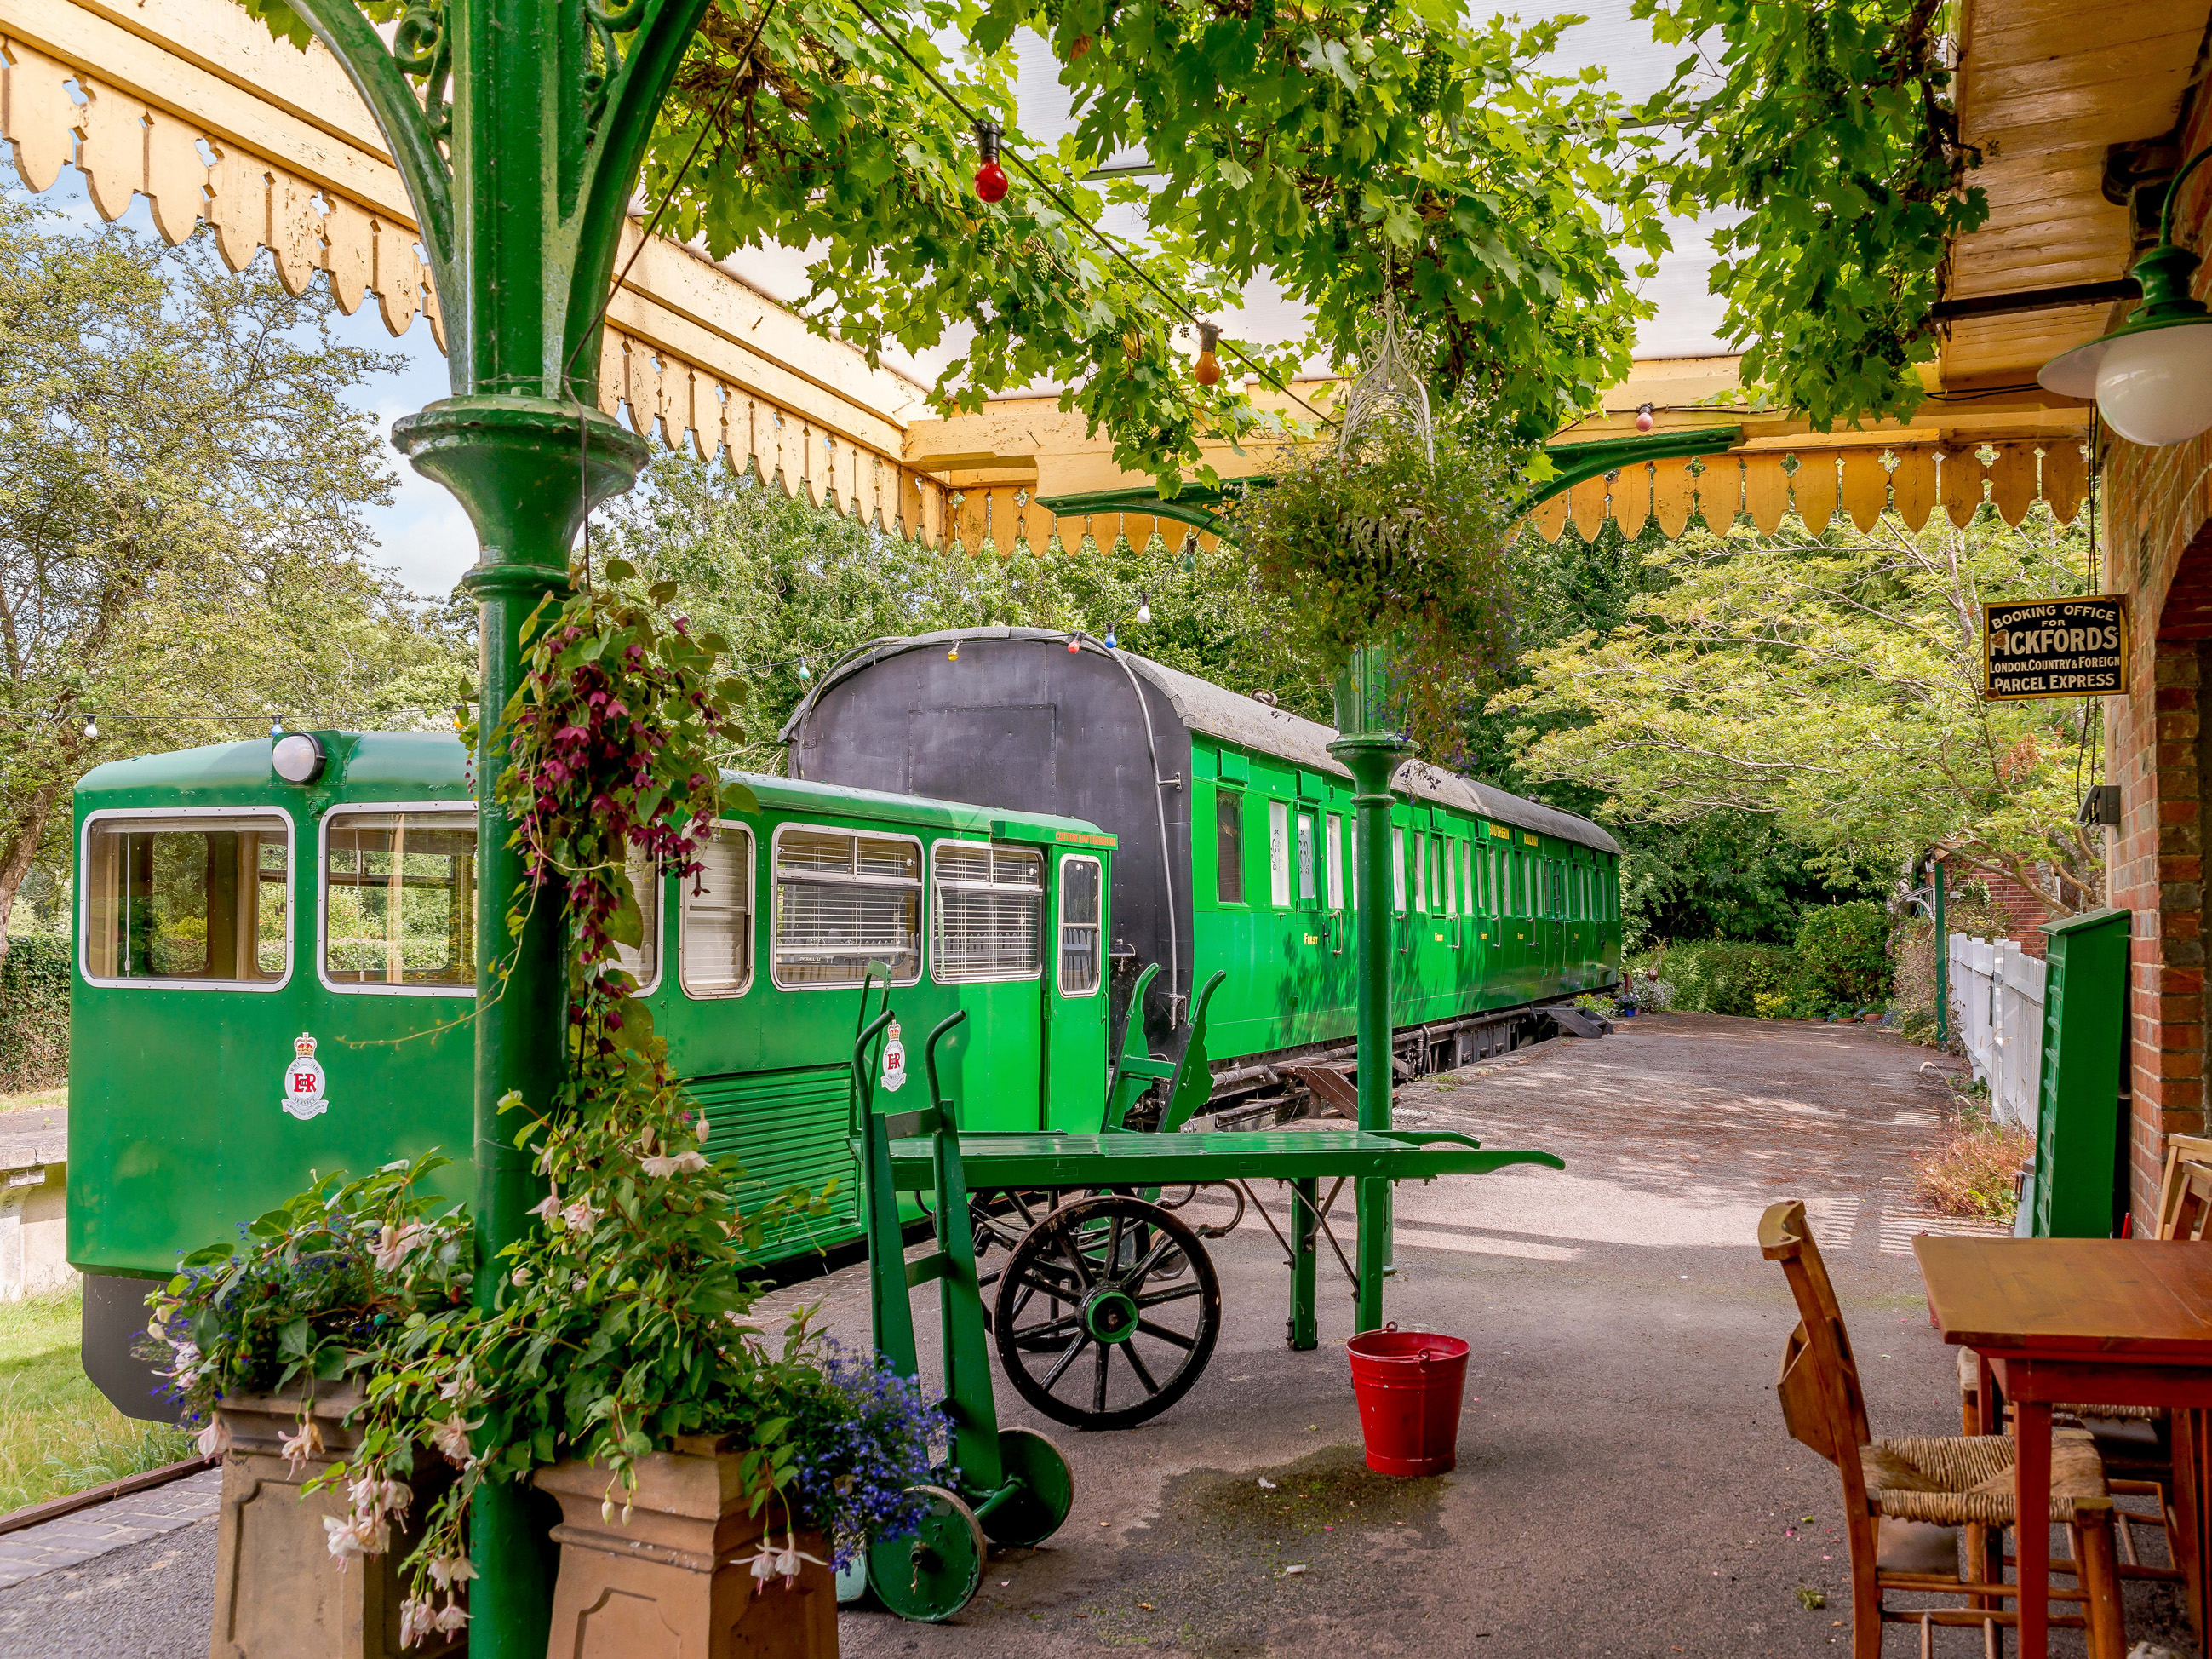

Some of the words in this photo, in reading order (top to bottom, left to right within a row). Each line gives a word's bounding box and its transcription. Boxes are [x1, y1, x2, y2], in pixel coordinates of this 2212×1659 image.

[1991, 606, 2056, 629] BOOKING
[2063, 605, 2116, 622] OFFICE
[2041, 619, 2066, 628] FOR
[1994, 677, 2047, 692] PARCEL
[2049, 673, 2115, 690] EXPRESS
[1304, 933, 1318, 944] FIRST
